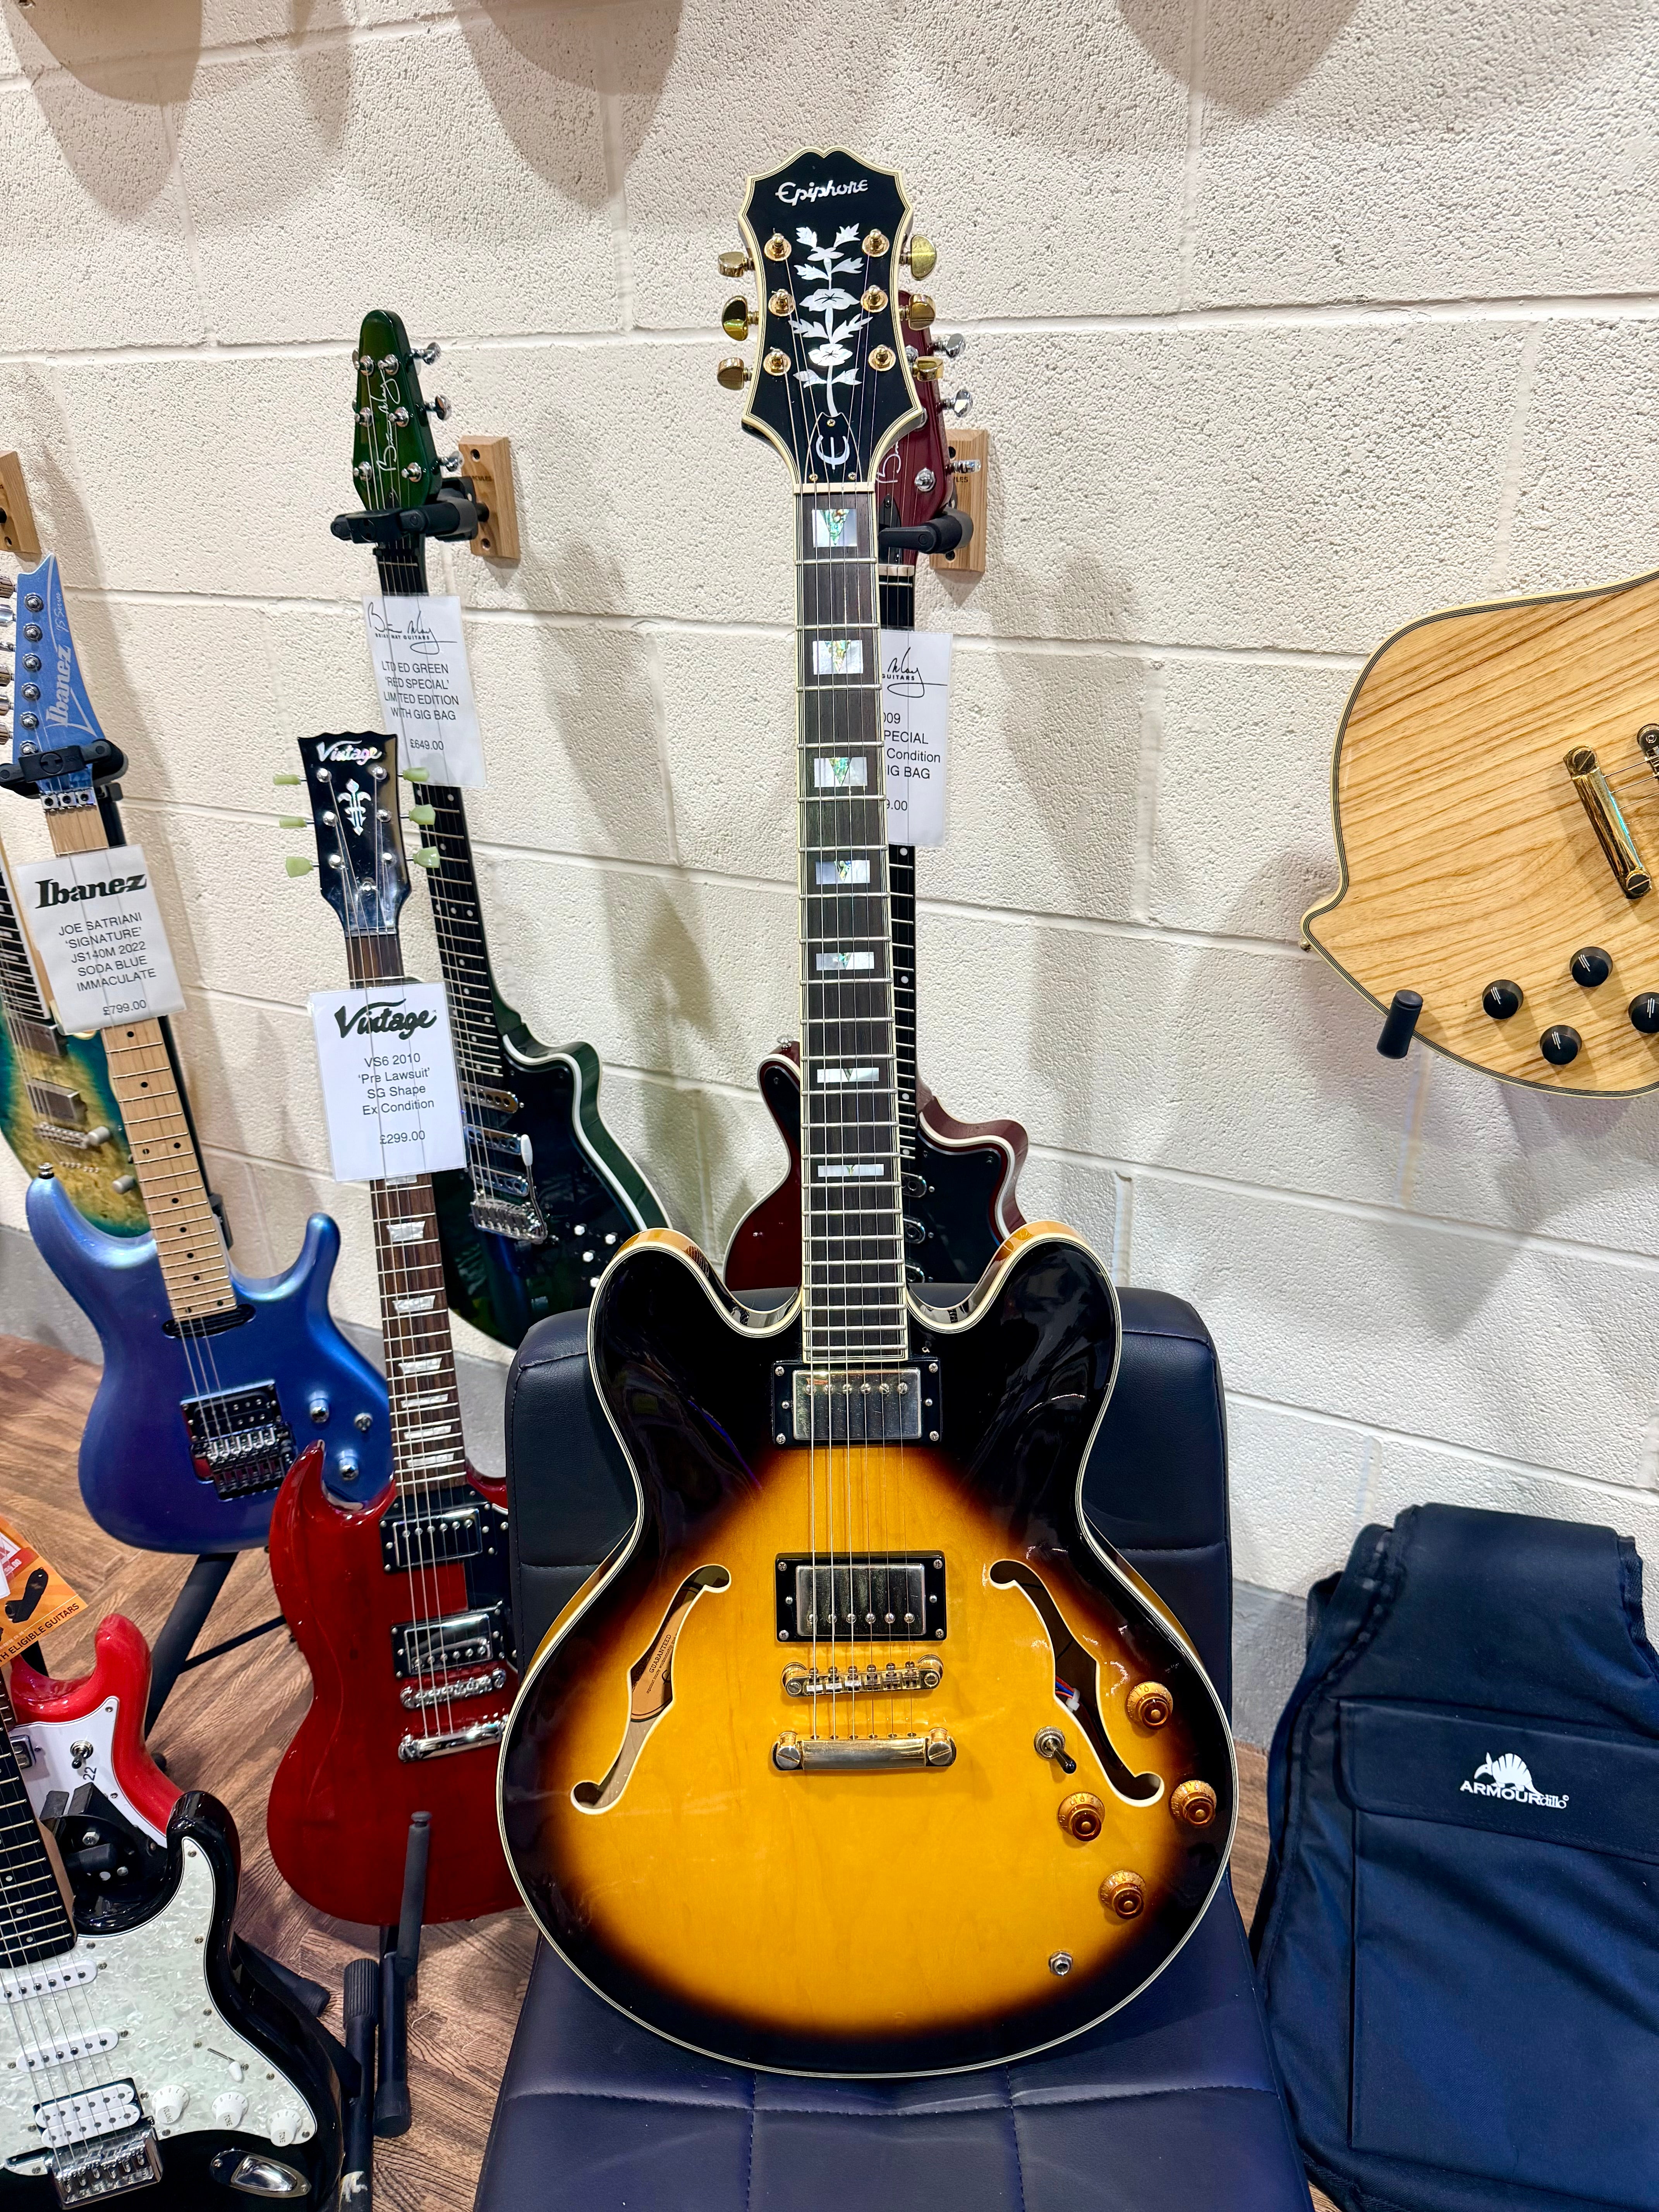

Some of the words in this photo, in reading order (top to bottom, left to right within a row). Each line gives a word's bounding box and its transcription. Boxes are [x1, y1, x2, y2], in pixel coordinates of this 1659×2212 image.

[775, 179, 869, 206] Epiphone
[381, 660, 397, 672] LTD
[397, 662, 410, 673] ED
[412, 663, 449, 674] GREEN
[45, 644, 71, 727] Ibanez
[383, 691, 416, 704] LIMTED
[417, 694, 460, 705] EDITION
[390, 707, 412, 719] WITH
[414, 709, 431, 720] GIG
[434, 710, 456, 720] BAG
[410, 738, 444, 751] £649.00
[884, 730, 929, 744] PECIAL
[316, 740, 383, 766] Vintage
[886, 747, 941, 763] Condition
[886, 764, 900, 776] IG
[904, 766, 930, 779] BAG
[886, 799, 907, 811] 9.00
[34, 874, 147, 909] Ibanez
[58, 923, 83, 936] JOE
[86, 912, 143, 931] SATRIANI
[71, 947, 117, 963] JS140M
[118, 941, 147, 955] 2022
[77, 963, 113, 977] SODA
[115, 955, 148, 970] BLUE
[76, 968, 157, 992] IMMACULATE
[103, 1000, 147, 1016] £799.00
[334, 998, 437, 1040] Vintage
[364, 1056, 389, 1068] VS6
[392, 1053, 421, 1065] 2010
[367, 1088, 386, 1099] SG
[389, 1085, 426, 1097] Shape
[362, 1105, 378, 1115] Ex
[381, 1099, 434, 1113] Condition
[380, 1130, 426, 1145] £299.00
[8, 1626, 46, 1654] ELIGIBLE
[45, 1603, 79, 1628] GUITARS
[649, 1634, 672, 1673] GUARANTEED
[82, 1767, 97, 1781] 22
[1460, 1780, 1568, 1809] ARMOURdillo
[223, 2114, 233, 2127] TONE
